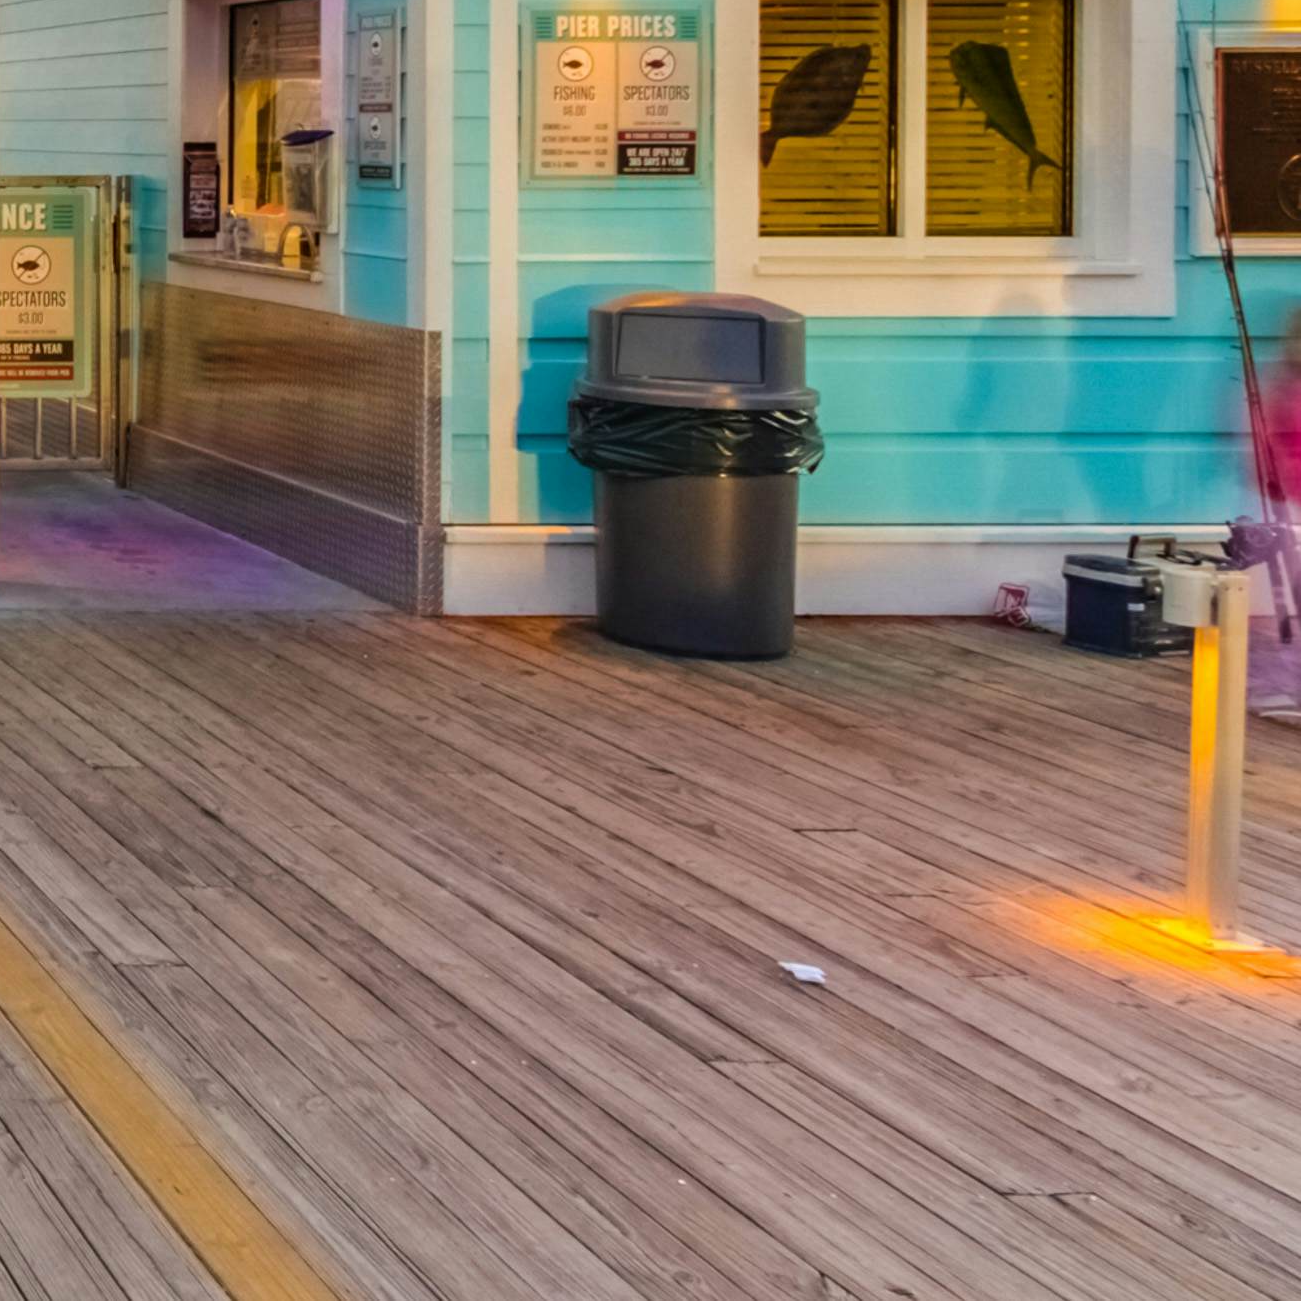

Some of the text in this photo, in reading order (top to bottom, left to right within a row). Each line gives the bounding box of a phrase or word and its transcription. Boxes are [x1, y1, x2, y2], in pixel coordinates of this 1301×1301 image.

[556, 15, 676, 38] PIER PRICES
[554, 86, 596, 101] FISHING
[623, 86, 690, 101] SPECTATORS
[626, 148, 637, 157] WE
[638, 148, 650, 157] ARE
[652, 148, 670, 157] OPEN
[643, 157, 660, 166] DAYS
[661, 157, 666, 166] A
[667, 157, 685, 166] YEAR
[18, 312, 44, 325] $3.00
[13, 343, 33, 355] DAYS
[34, 343, 41, 355] A
[42, 343, 63, 355] YEAR
